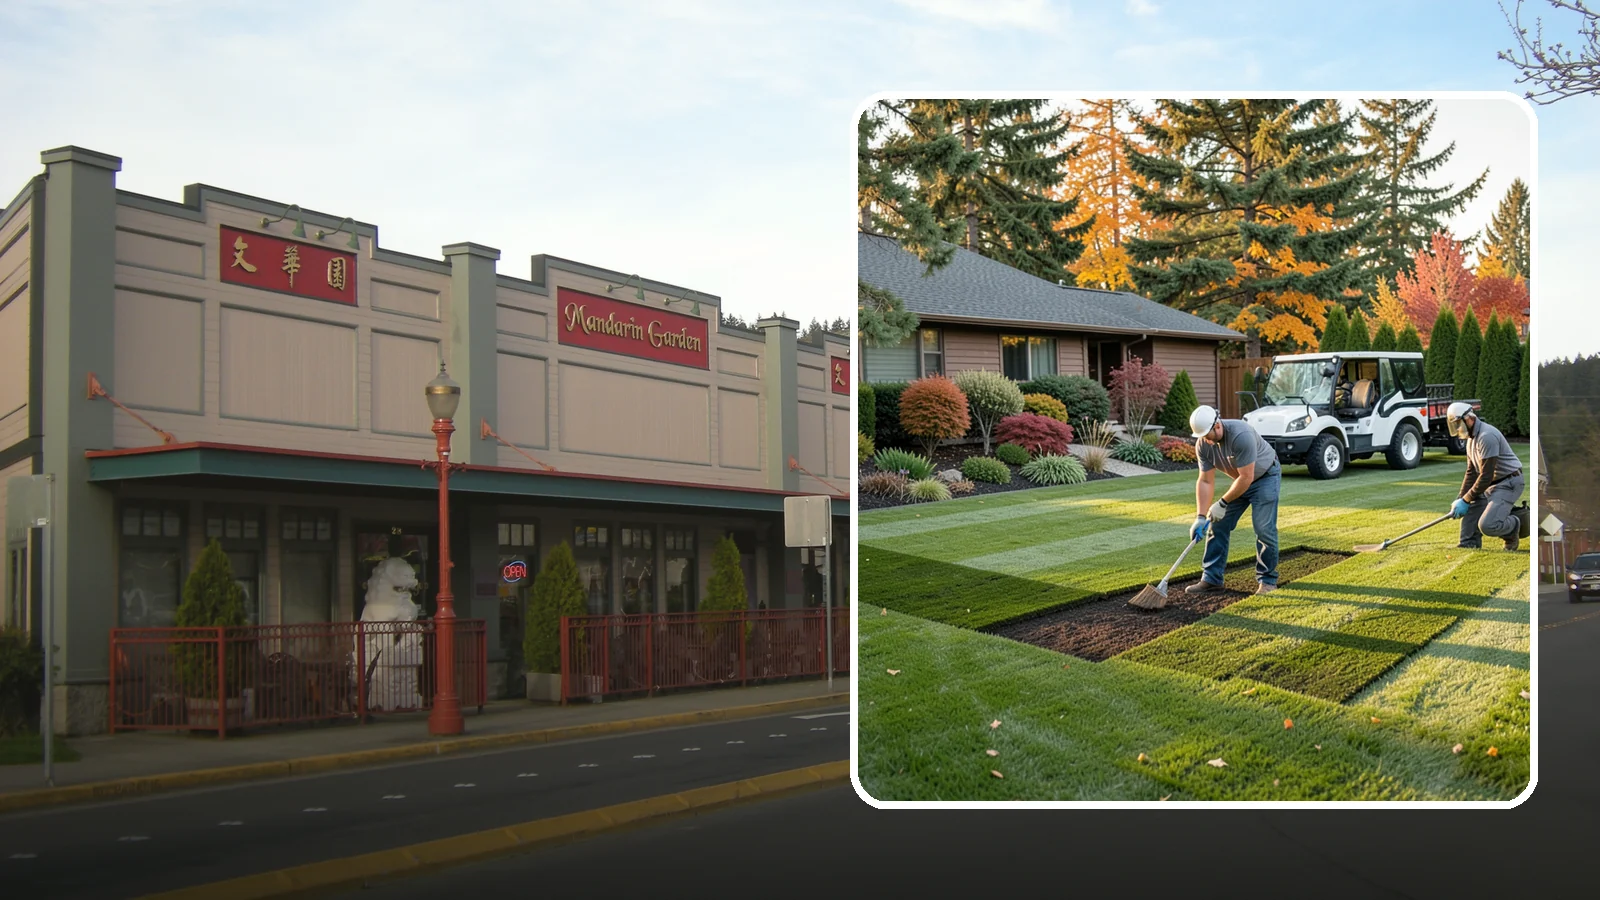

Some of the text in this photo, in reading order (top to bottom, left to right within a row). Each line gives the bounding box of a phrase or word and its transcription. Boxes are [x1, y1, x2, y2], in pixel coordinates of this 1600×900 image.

[231, 236, 346, 291] 文華園
[565, 302, 701, 352] Mandarin Garden
[503, 565, 527, 578] OPEN
